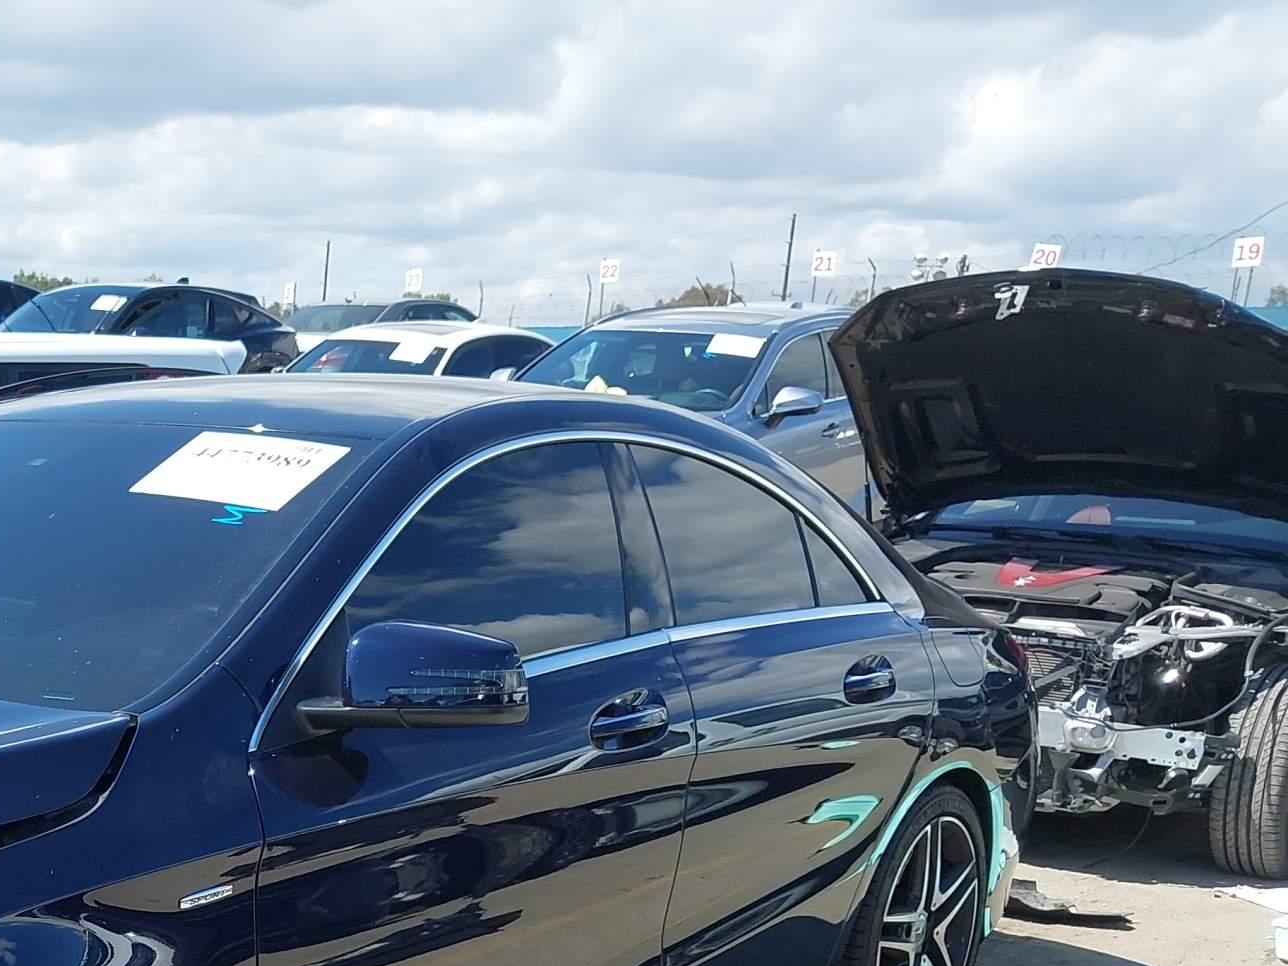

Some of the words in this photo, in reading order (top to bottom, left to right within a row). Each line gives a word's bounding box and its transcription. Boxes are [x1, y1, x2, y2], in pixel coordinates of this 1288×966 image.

[1032, 249, 1057, 266] 20
[1234, 243, 1261, 261] 19
[601, 264, 618, 279] 22
[814, 256, 833, 272] 21
[407, 273, 420, 287] 23
